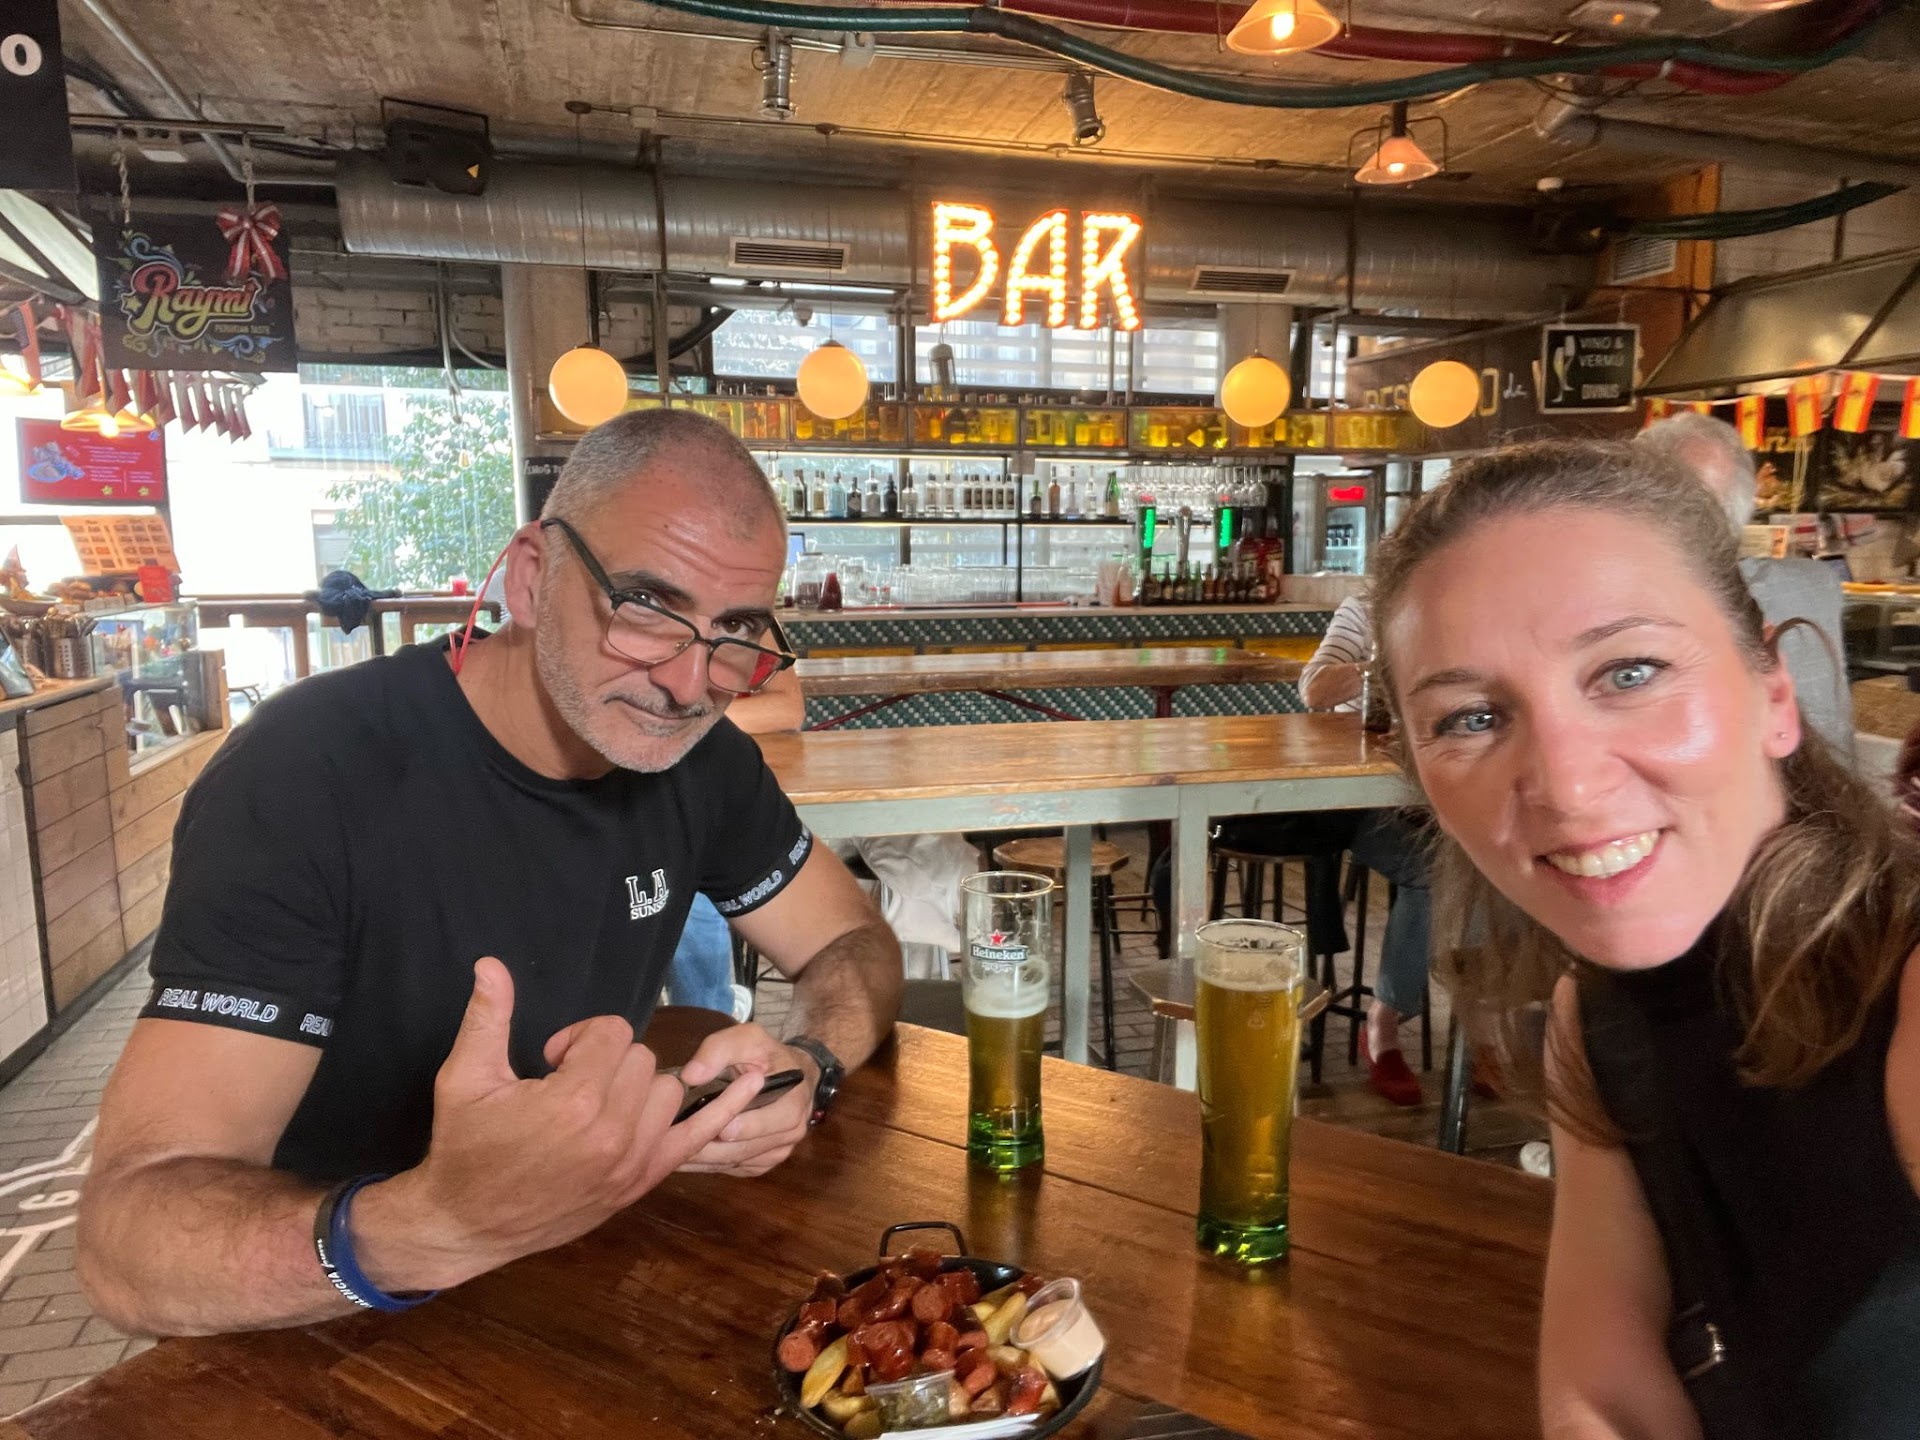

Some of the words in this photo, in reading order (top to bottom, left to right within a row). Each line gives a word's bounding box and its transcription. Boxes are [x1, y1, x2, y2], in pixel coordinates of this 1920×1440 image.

[931, 200, 1143, 331] BAR
[131, 262, 258, 336] Raymi
[739, 869, 783, 906] WORLD
[973, 946, 1024, 959] Heineken
[158, 988, 197, 1010] REAL
[201, 992, 278, 1023] WORLD
